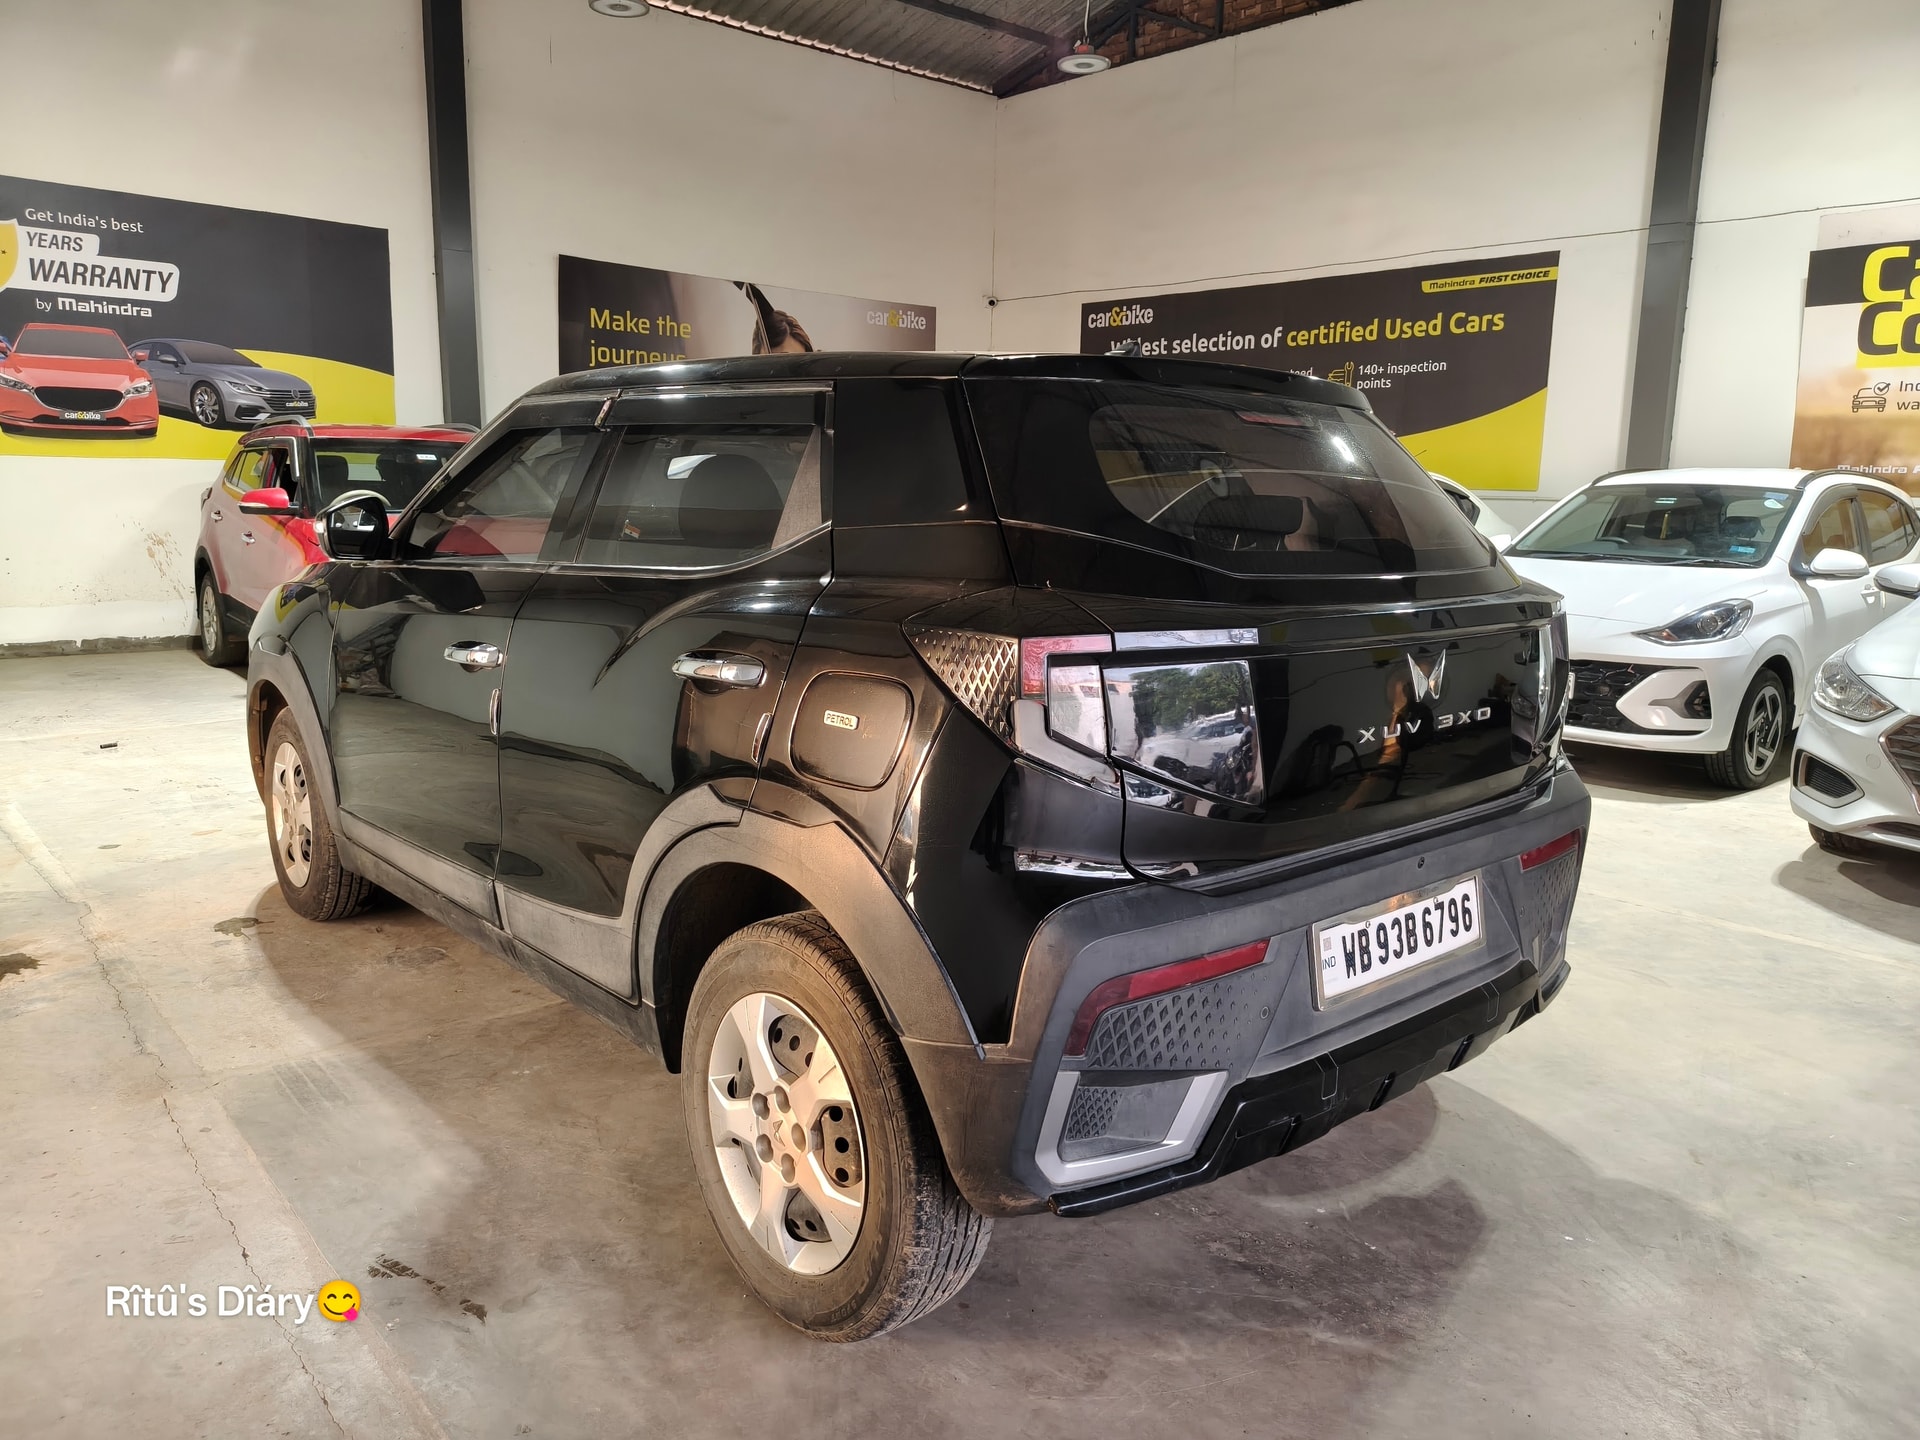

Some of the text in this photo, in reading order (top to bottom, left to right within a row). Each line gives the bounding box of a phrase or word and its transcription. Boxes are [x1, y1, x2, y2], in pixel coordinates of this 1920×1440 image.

[25, 208, 144, 233] Get India's best
[26, 231, 83, 252] YEARS
[29, 257, 174, 294] WARRANTY
[1429, 270, 1551, 290] Mahindra FIRST CHOICE
[36, 297, 152, 317] by Mahindra
[1087, 304, 1154, 329] car&bike
[589, 307, 692, 338] Make the
[866, 309, 927, 330] car&bike
[1171, 330, 1255, 354] selection
[1260, 326, 1283, 349] of
[1286, 318, 1378, 347] certified
[1385, 312, 1443, 340] Used
[1449, 311, 1505, 335] Cars
[1358, 360, 1447, 376] 140+ inspection
[1356, 377, 1392, 390] points
[64, 410, 101, 420] car&bike
[825, 712, 854, 728] PETROL
[1358, 706, 1492, 744] XUV 3XO
